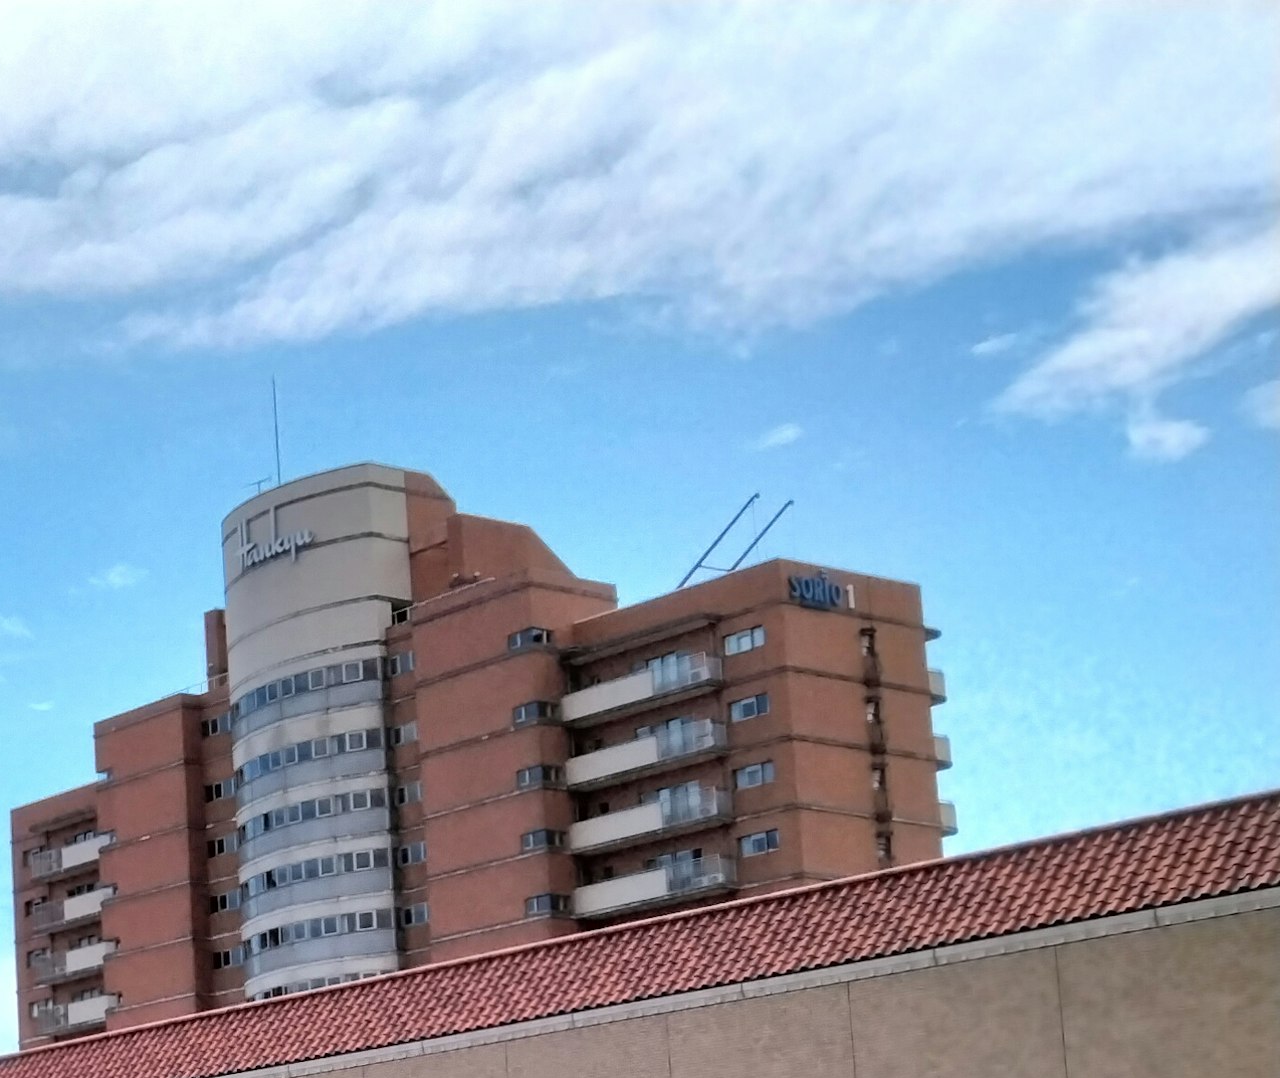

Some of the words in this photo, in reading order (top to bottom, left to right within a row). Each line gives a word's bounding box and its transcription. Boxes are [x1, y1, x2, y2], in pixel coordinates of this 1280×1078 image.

[236, 505, 315, 570] Hankyu
[788, 571, 843, 606] SORIO
[846, 584, 856, 609] 1
